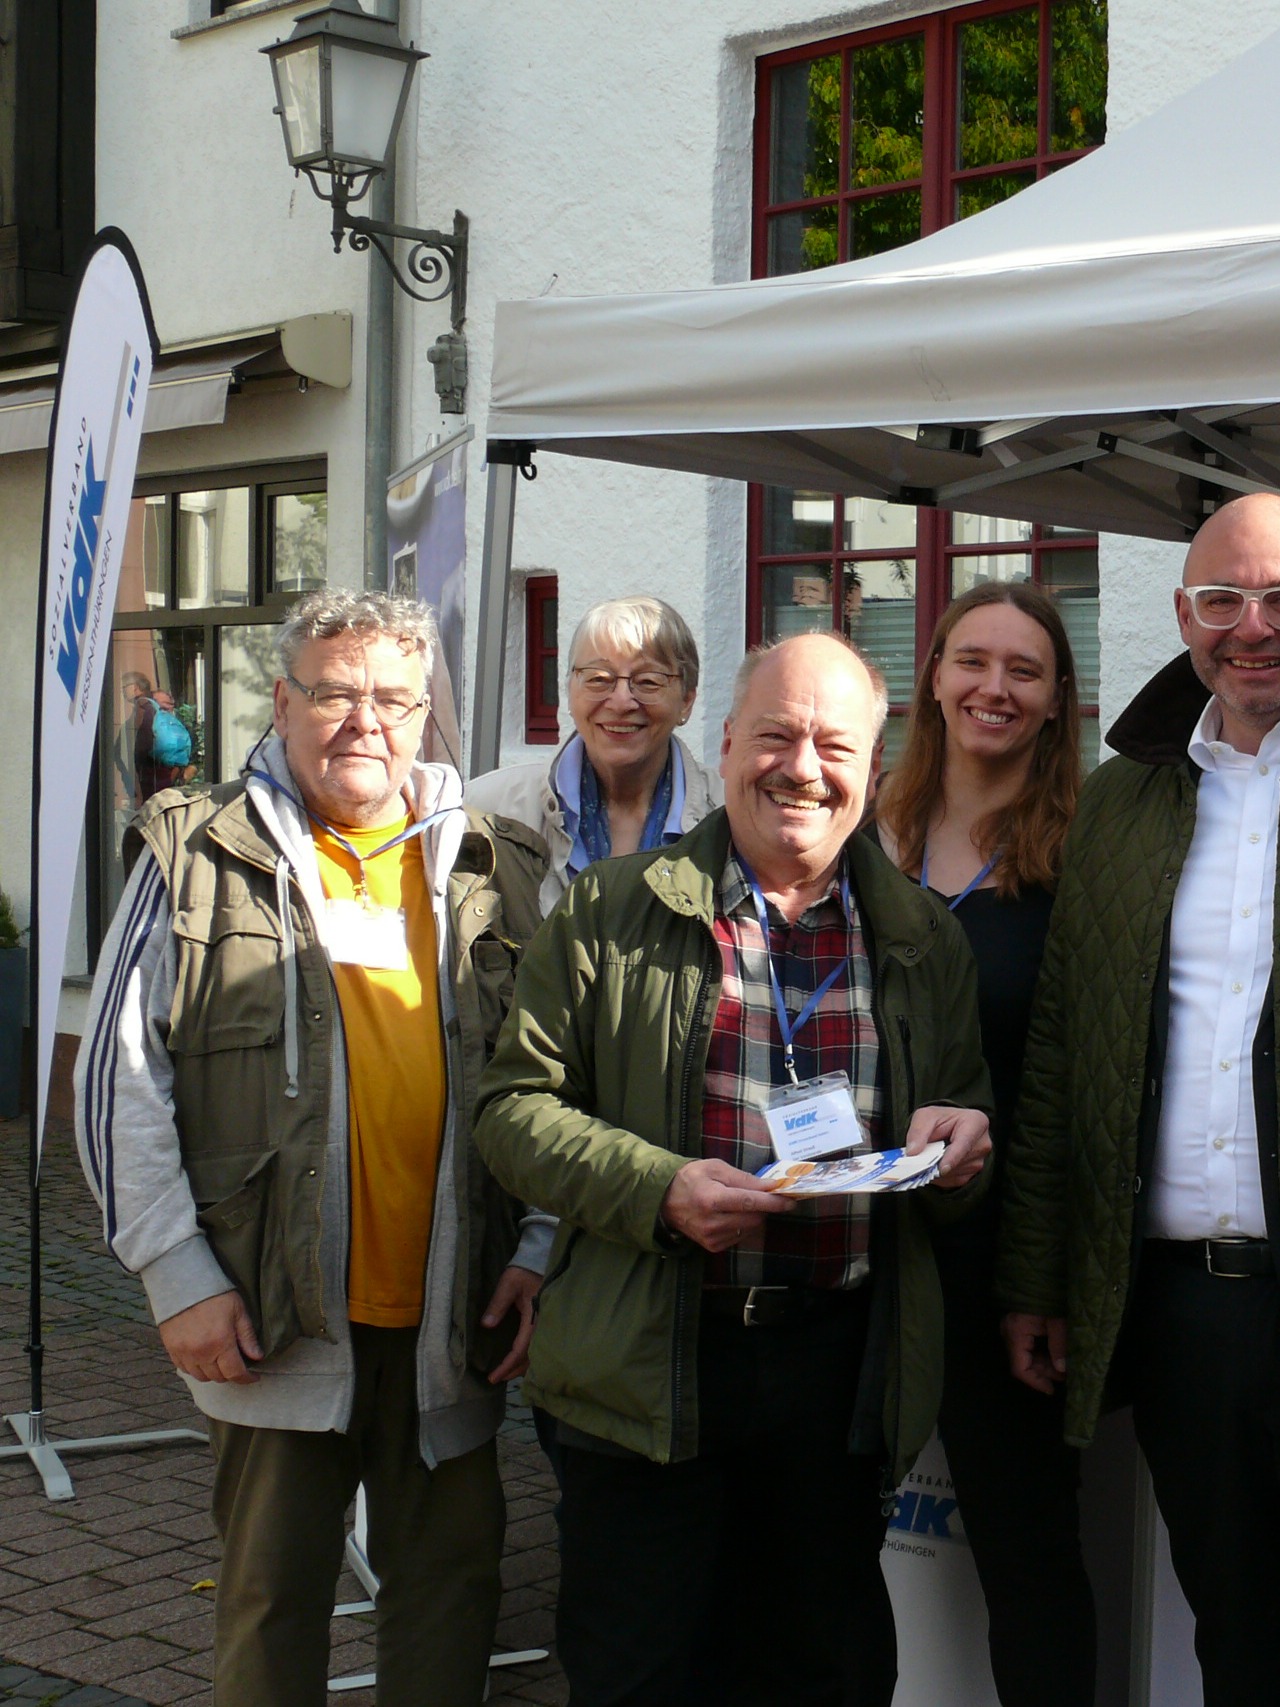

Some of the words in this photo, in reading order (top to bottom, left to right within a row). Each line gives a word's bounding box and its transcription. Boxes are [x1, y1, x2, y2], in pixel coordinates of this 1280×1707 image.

[49, 416, 87, 661] SOZIALVERBAND
[57, 433, 107, 701] VdK
[79, 530, 113, 724] HESSEN-THÜRINGEN
[784, 1110, 818, 1131] VdK
[883, 1539, 936, 1558] THÜRINGEN
[888, 1490, 957, 1538] dK
